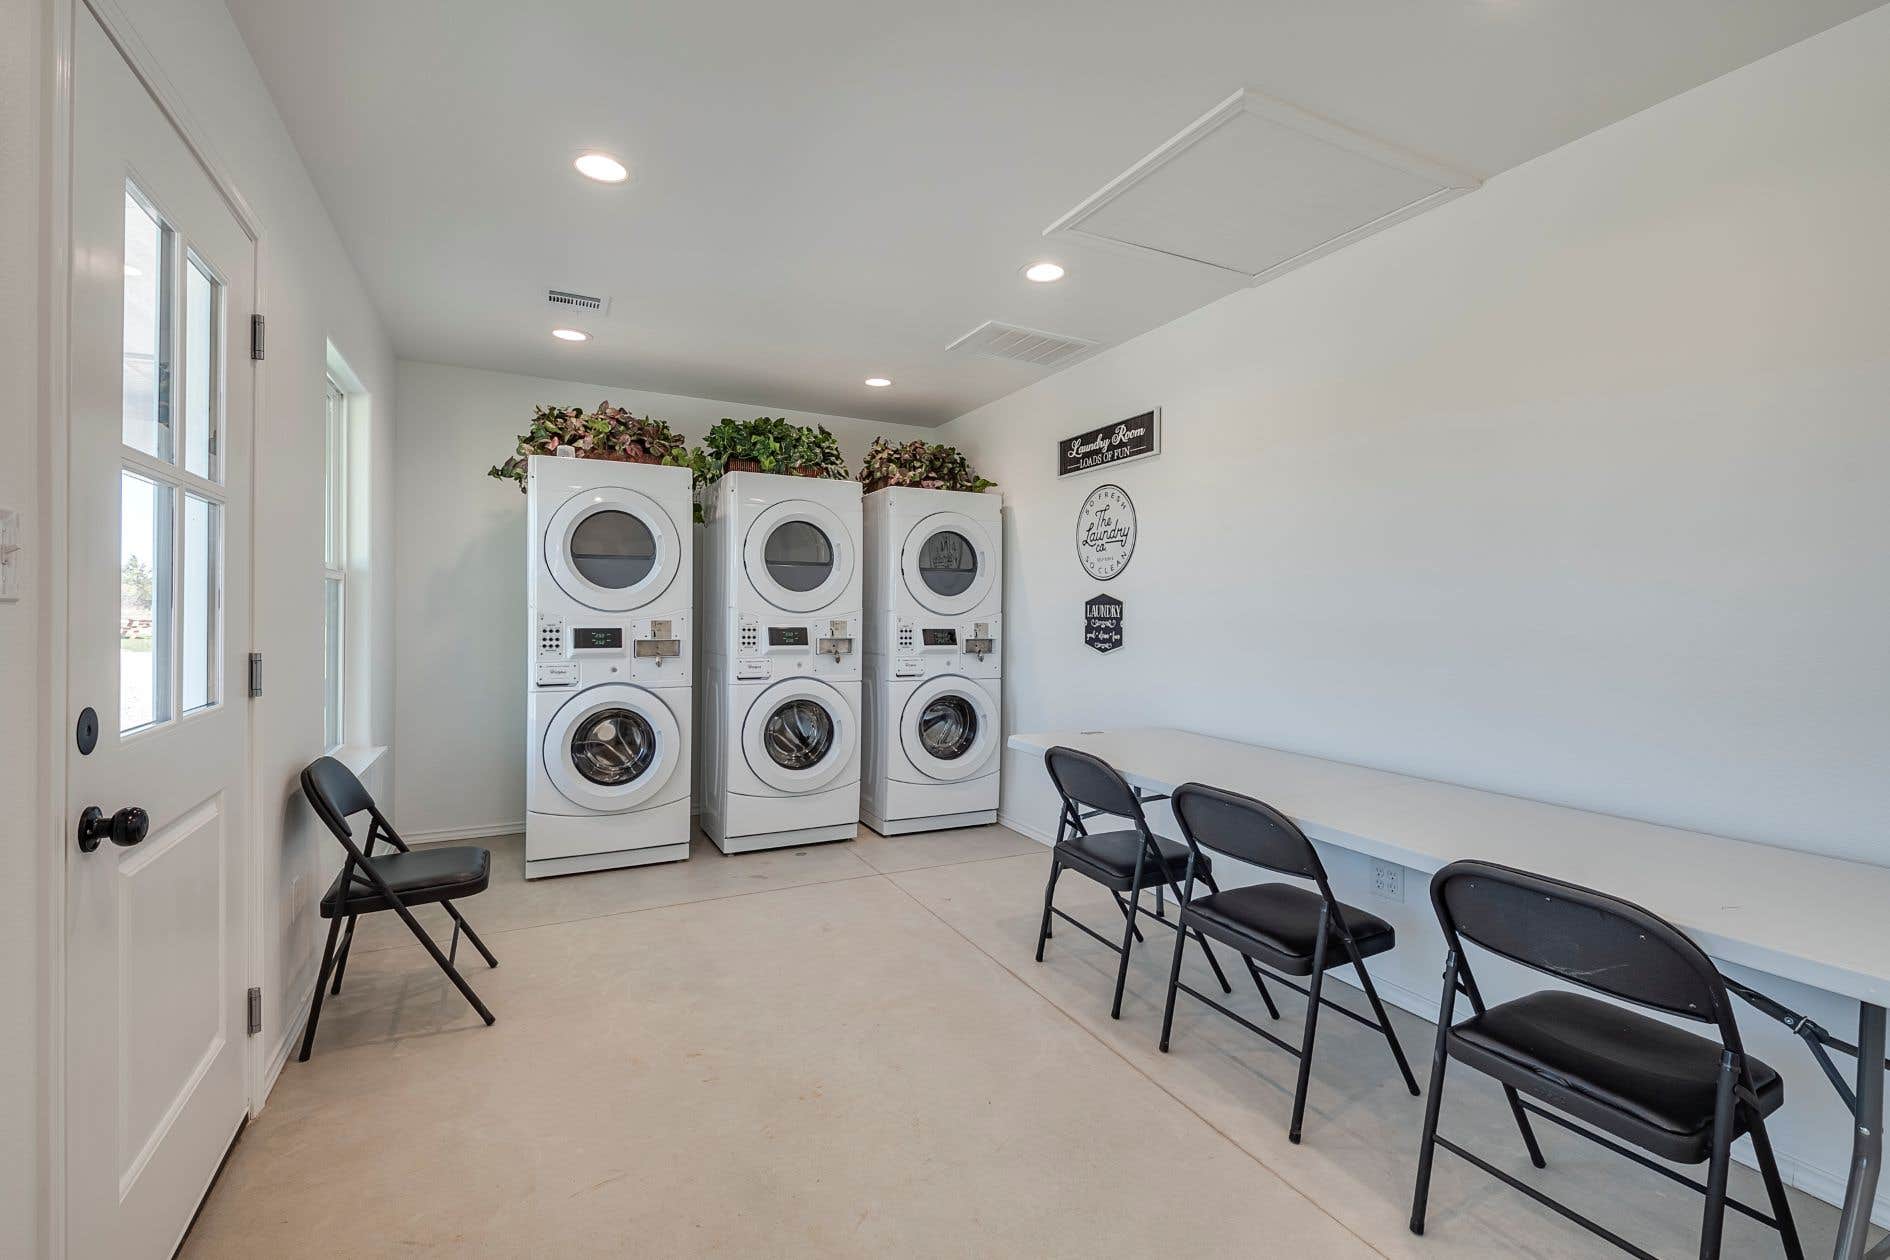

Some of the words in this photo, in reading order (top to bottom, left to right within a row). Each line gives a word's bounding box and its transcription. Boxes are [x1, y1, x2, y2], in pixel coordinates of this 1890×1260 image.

[1068, 434, 1110, 457] Laundry
[1112, 424, 1145, 445] Room
[1080, 454, 1102, 468] LOADS
[1103, 452, 1113, 461] OF
[1114, 446, 1131, 459] FUN
[1085, 500, 1095, 515] SO
[1098, 492, 1126, 510] FRESH
[1095, 504, 1112, 530] The
[1082, 519, 1130, 547] Laundry
[1085, 556, 1095, 569] SO
[1098, 551, 1127, 574] CLEAN
[1087, 604, 1121, 618] LAUNDRY
